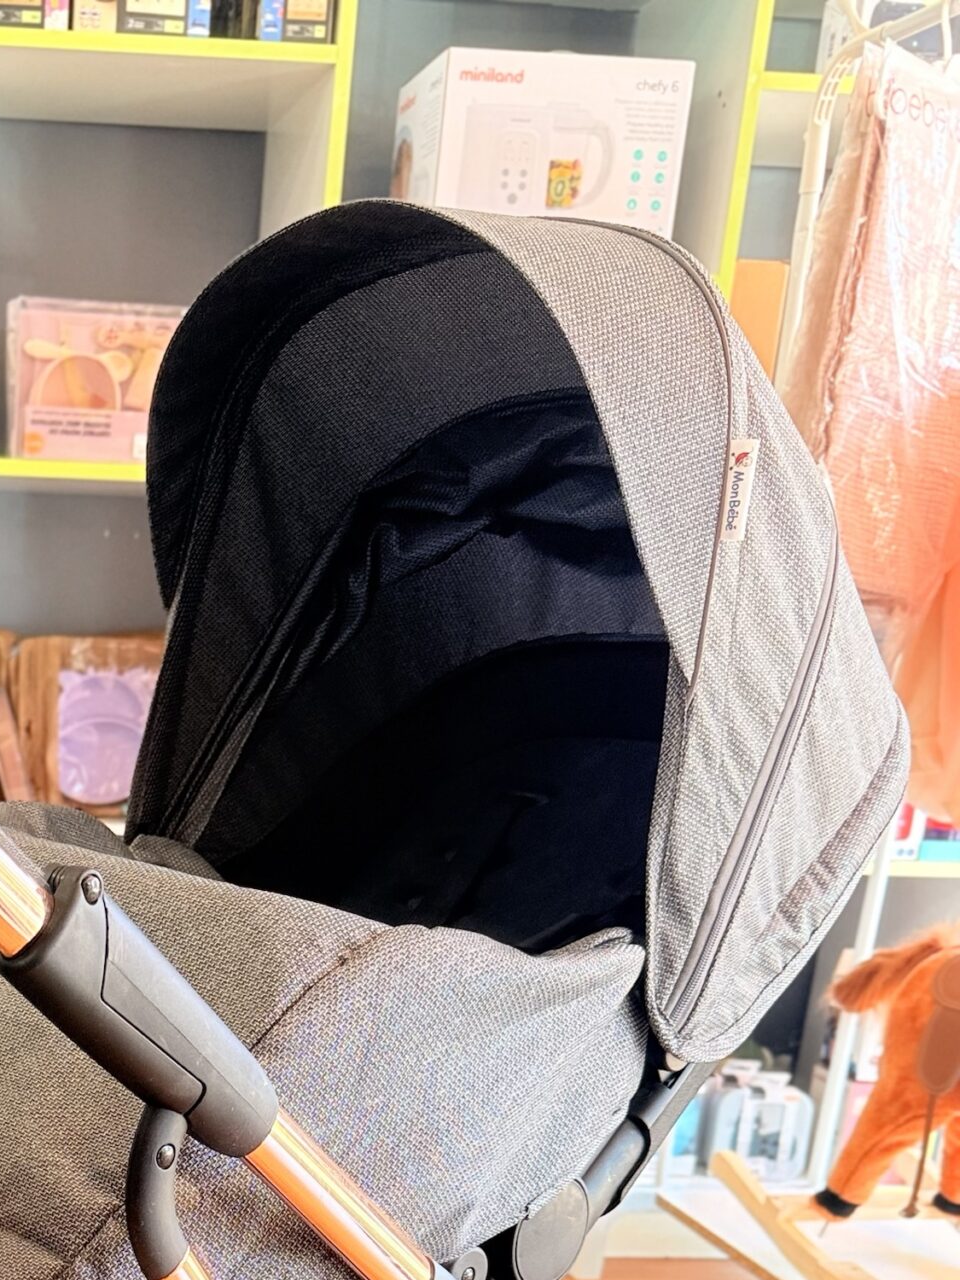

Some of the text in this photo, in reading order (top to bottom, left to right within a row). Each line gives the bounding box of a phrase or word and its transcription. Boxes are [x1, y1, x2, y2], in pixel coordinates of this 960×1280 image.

[460, 65, 525, 84] miniland
[636, 78, 680, 95] chefy 6
